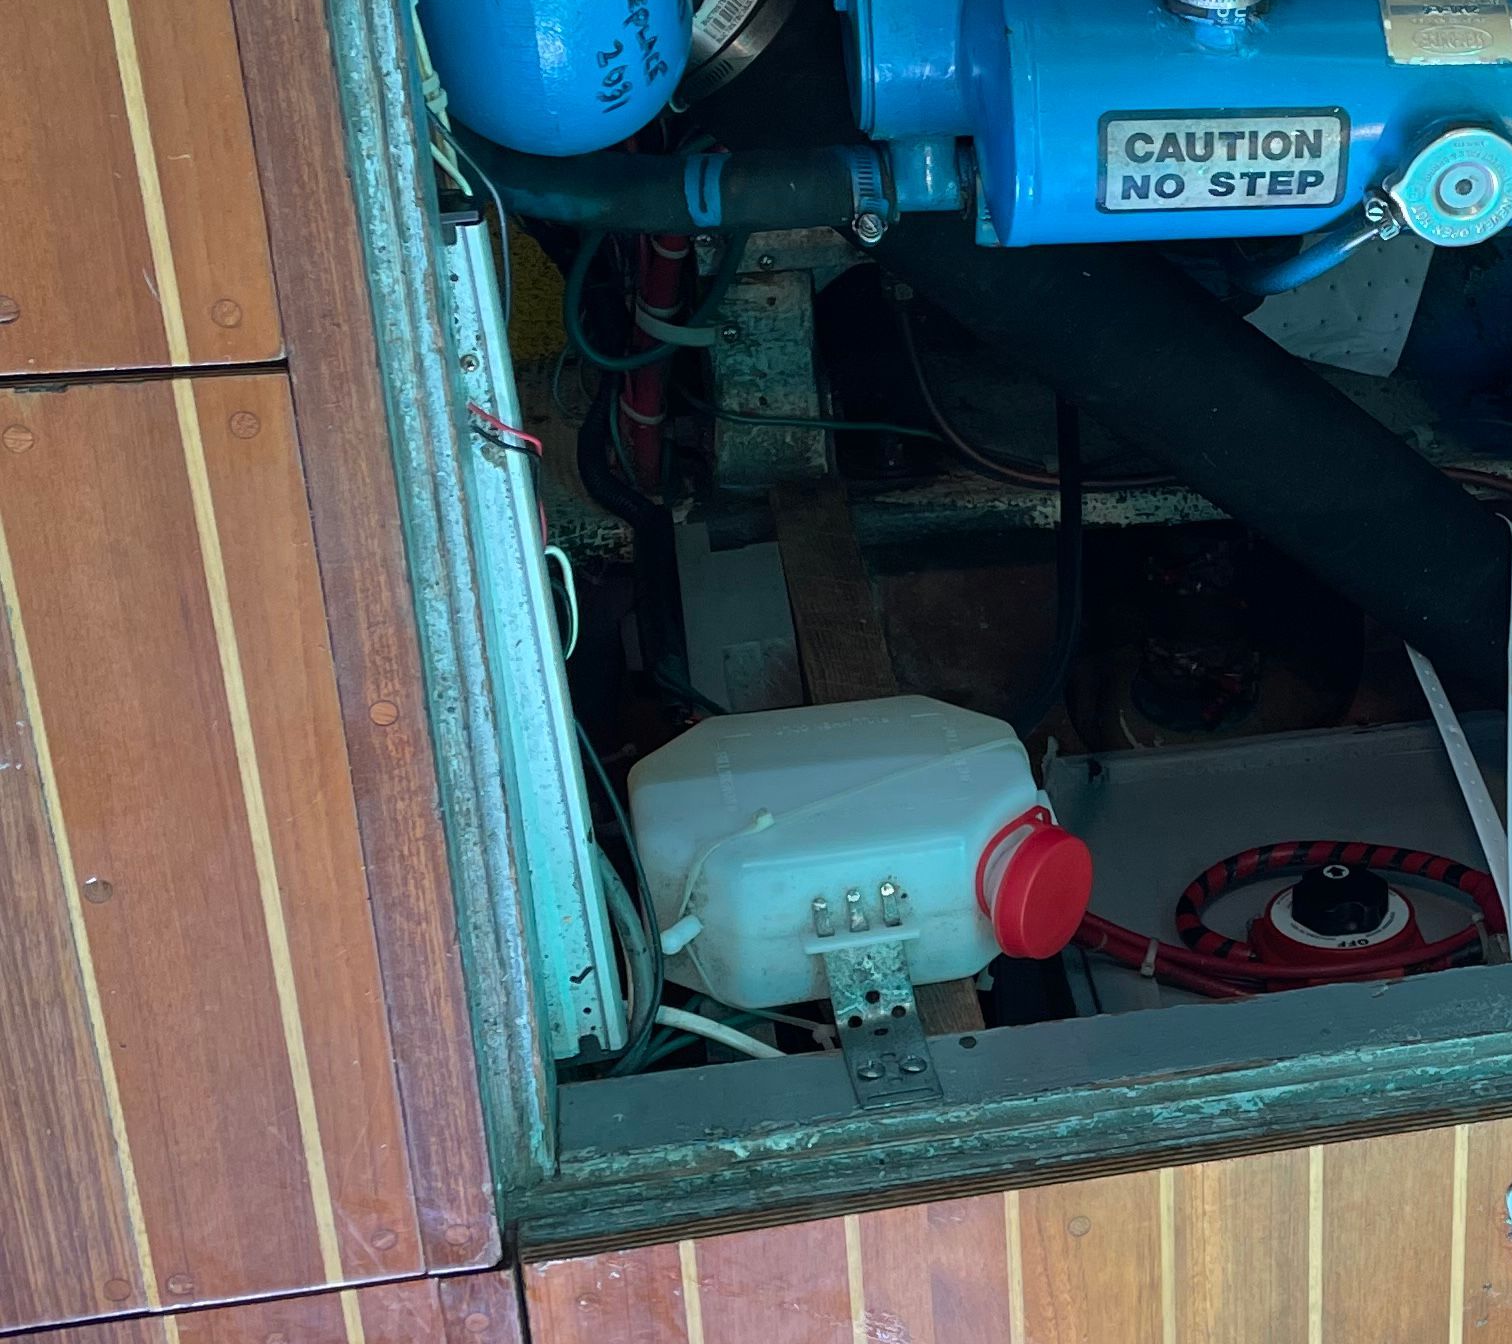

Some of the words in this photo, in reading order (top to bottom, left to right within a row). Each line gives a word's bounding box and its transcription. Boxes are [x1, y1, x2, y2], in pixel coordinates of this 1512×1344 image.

[1124, 129, 1323, 163] CAUTION
[1121, 174, 1186, 201] NO
[1208, 170, 1325, 197] STEP
